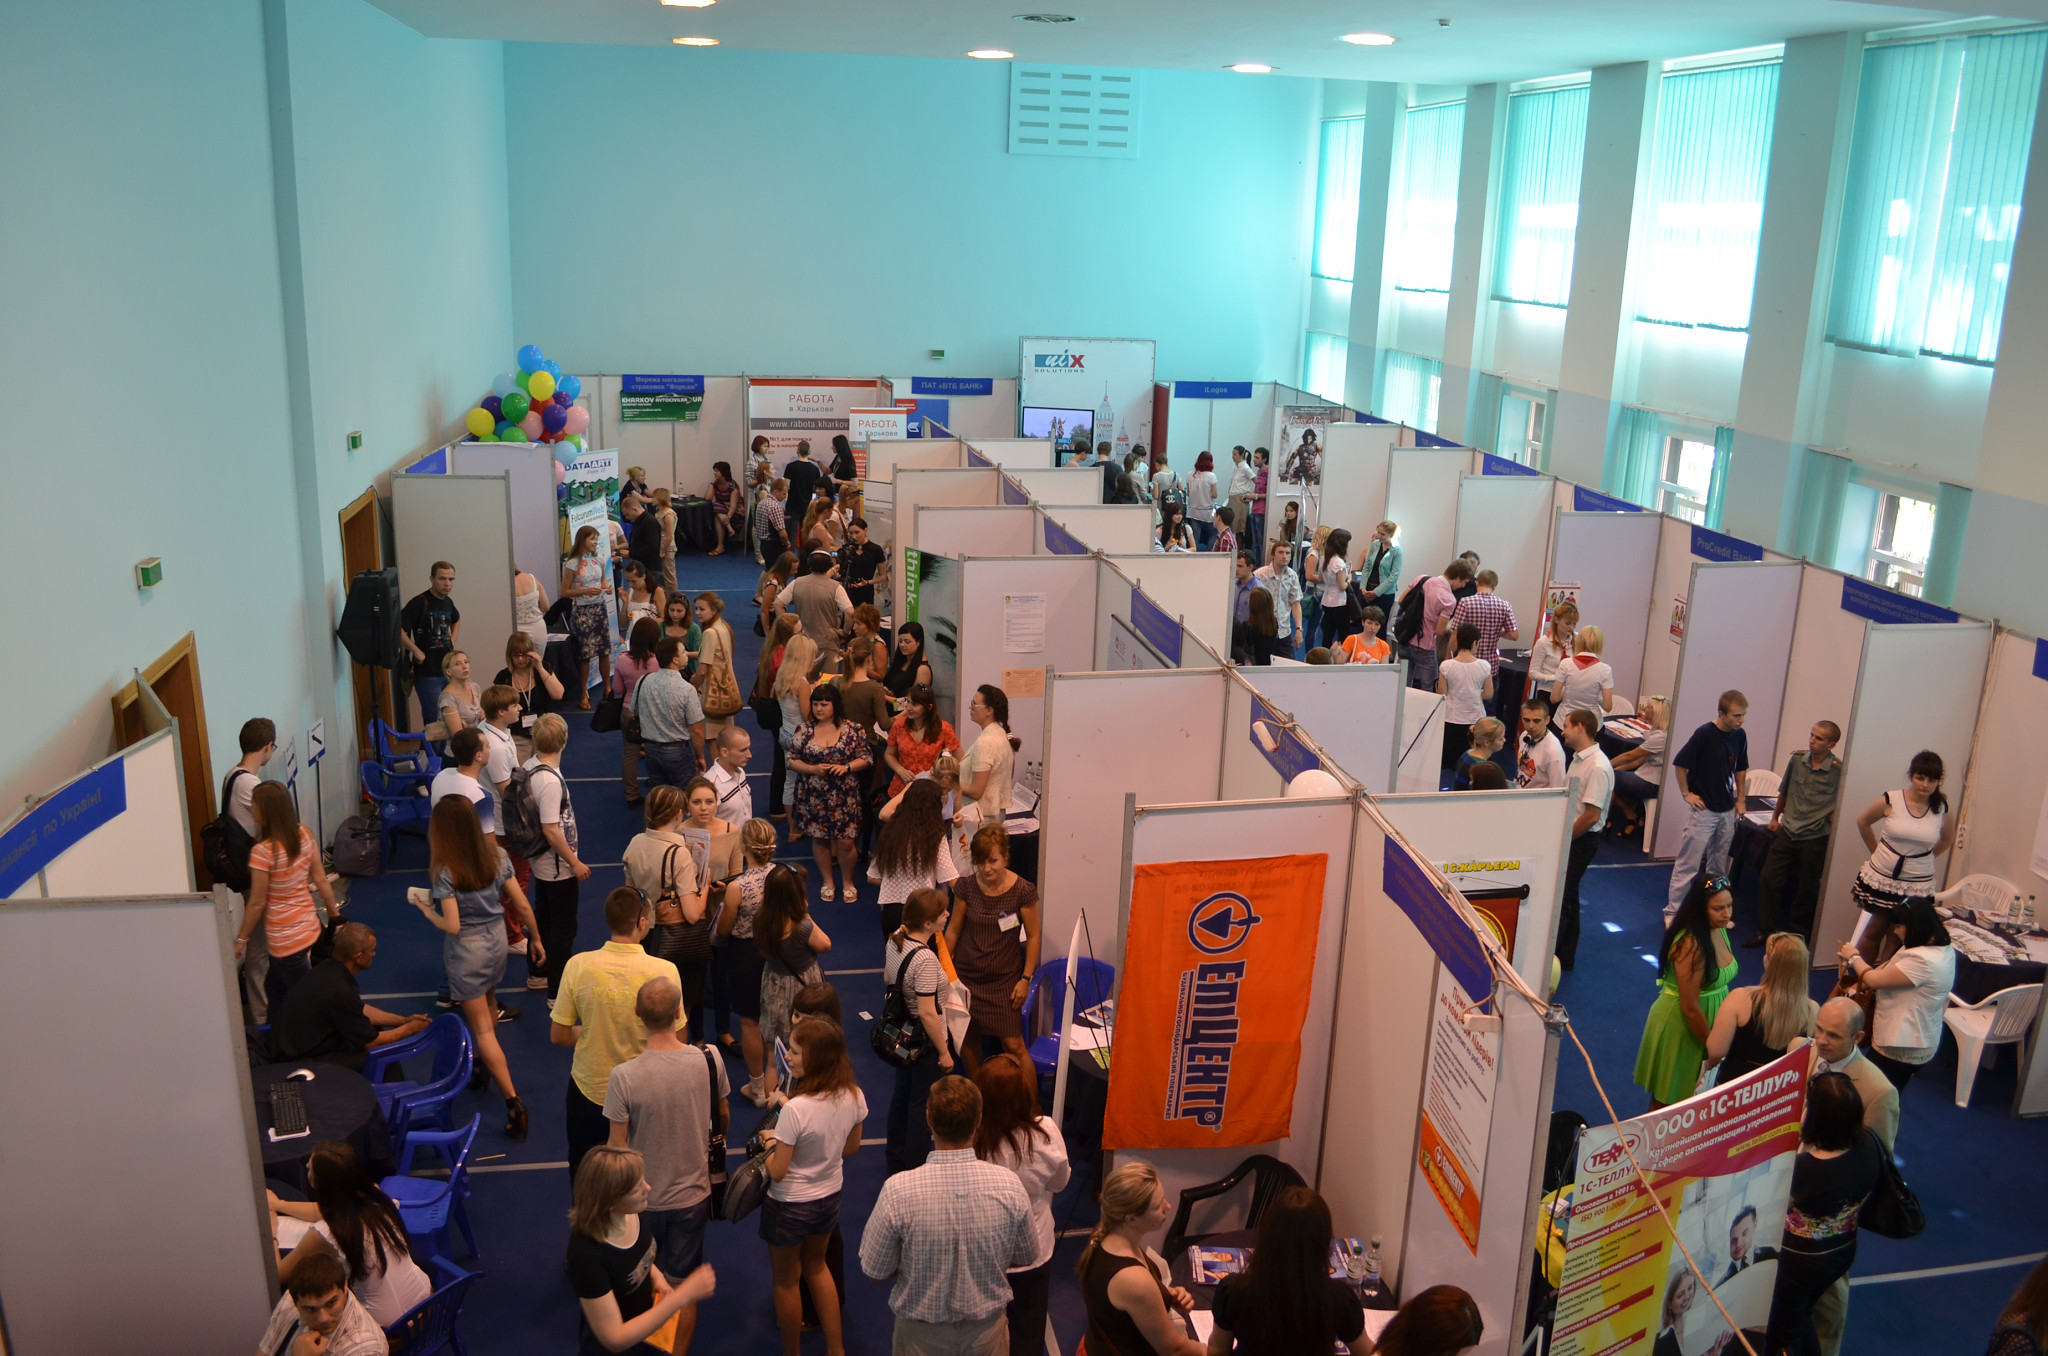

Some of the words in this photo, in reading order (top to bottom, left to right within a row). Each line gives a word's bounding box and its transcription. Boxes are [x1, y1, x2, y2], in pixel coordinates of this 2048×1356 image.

[788, 394, 835, 403] РАБОТА
[921, 381, 937, 389] ПАТ
[938, 382, 958, 390] «ВТБ
[959, 382, 983, 390] БАНК»
[1204, 386, 1228, 394] iLogos
[796, 404, 834, 413] Харькове
[858, 419, 898, 428] РАБОТА
[865, 430, 898, 438] Харькове
[1697, 537, 1731, 559] ProCredit
[906, 550, 919, 605] think
[59, 787, 102, 826] Україні
[1179, 959, 1247, 1127] ЕПІЦЕНТР
[1471, 1035, 1494, 1071] лідерів!
[1654, 1108, 1695, 1140] ООО
[1698, 1069, 1800, 1121] «1С-ТЕЛЛУР»
[1648, 1131, 1703, 1162] Крупнейшая
[1703, 1108, 1761, 1136] национальная
[1761, 1090, 1799, 1112] компания
[1658, 1151, 1684, 1168] сфере
[1685, 1126, 1746, 1155] автоматизации
[1745, 1105, 1792, 1132] управления
[1575, 1195, 1609, 1214] Основана
[1614, 1184, 1631, 1197] 1991
[1567, 1228, 1610, 1250] Программное
[1610, 1211, 1648, 1232] обеспечение
[1580, 1212, 1593, 1223] ISO
[1560, 1273, 1601, 1294] Комплексная
[1600, 1252, 1646, 1276] автоматизация
[1553, 1320, 1587, 1339] Подготовка
[1587, 1304, 1621, 1324] персонала
